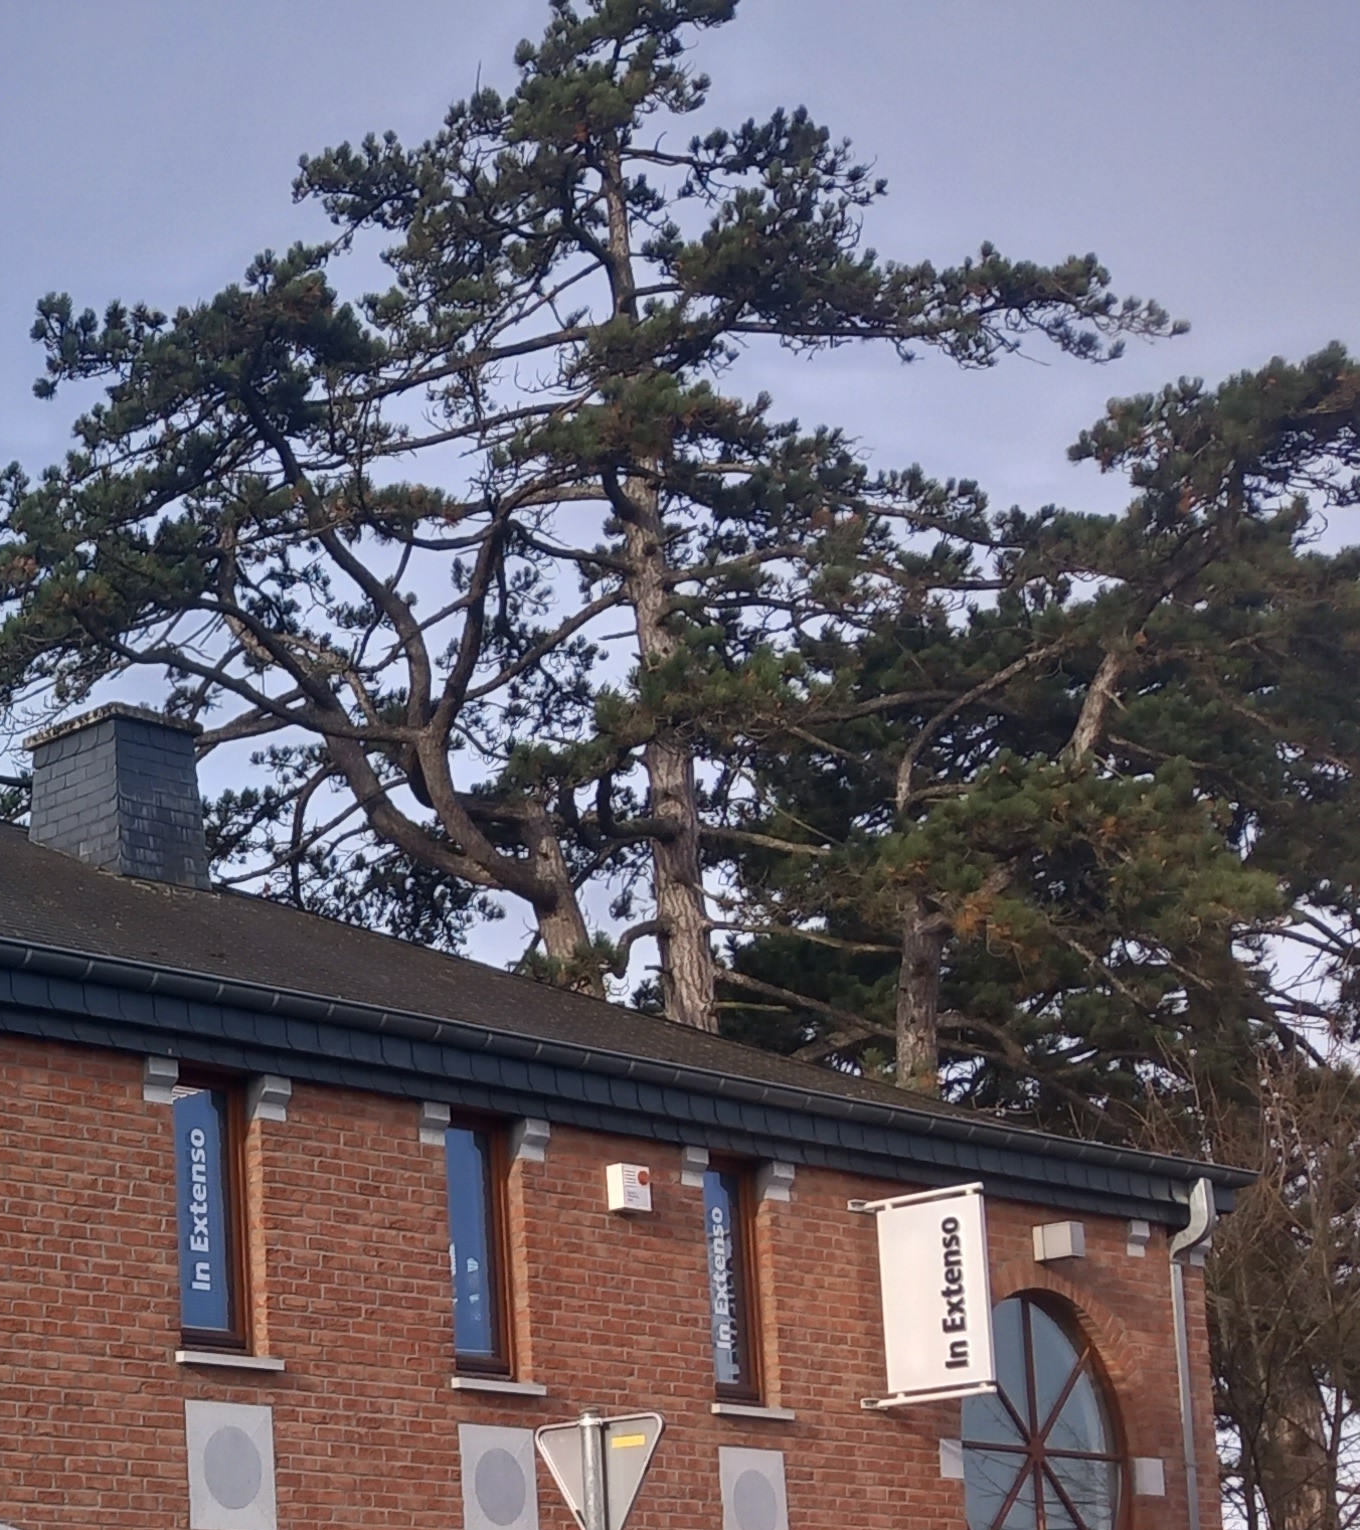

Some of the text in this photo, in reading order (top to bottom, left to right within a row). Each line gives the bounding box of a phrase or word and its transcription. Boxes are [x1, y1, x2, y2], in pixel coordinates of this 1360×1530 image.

[189, 1128, 211, 1291] In Extenso
[711, 1206, 731, 1351] In Extenso
[941, 1216, 969, 1370] In Extenso
